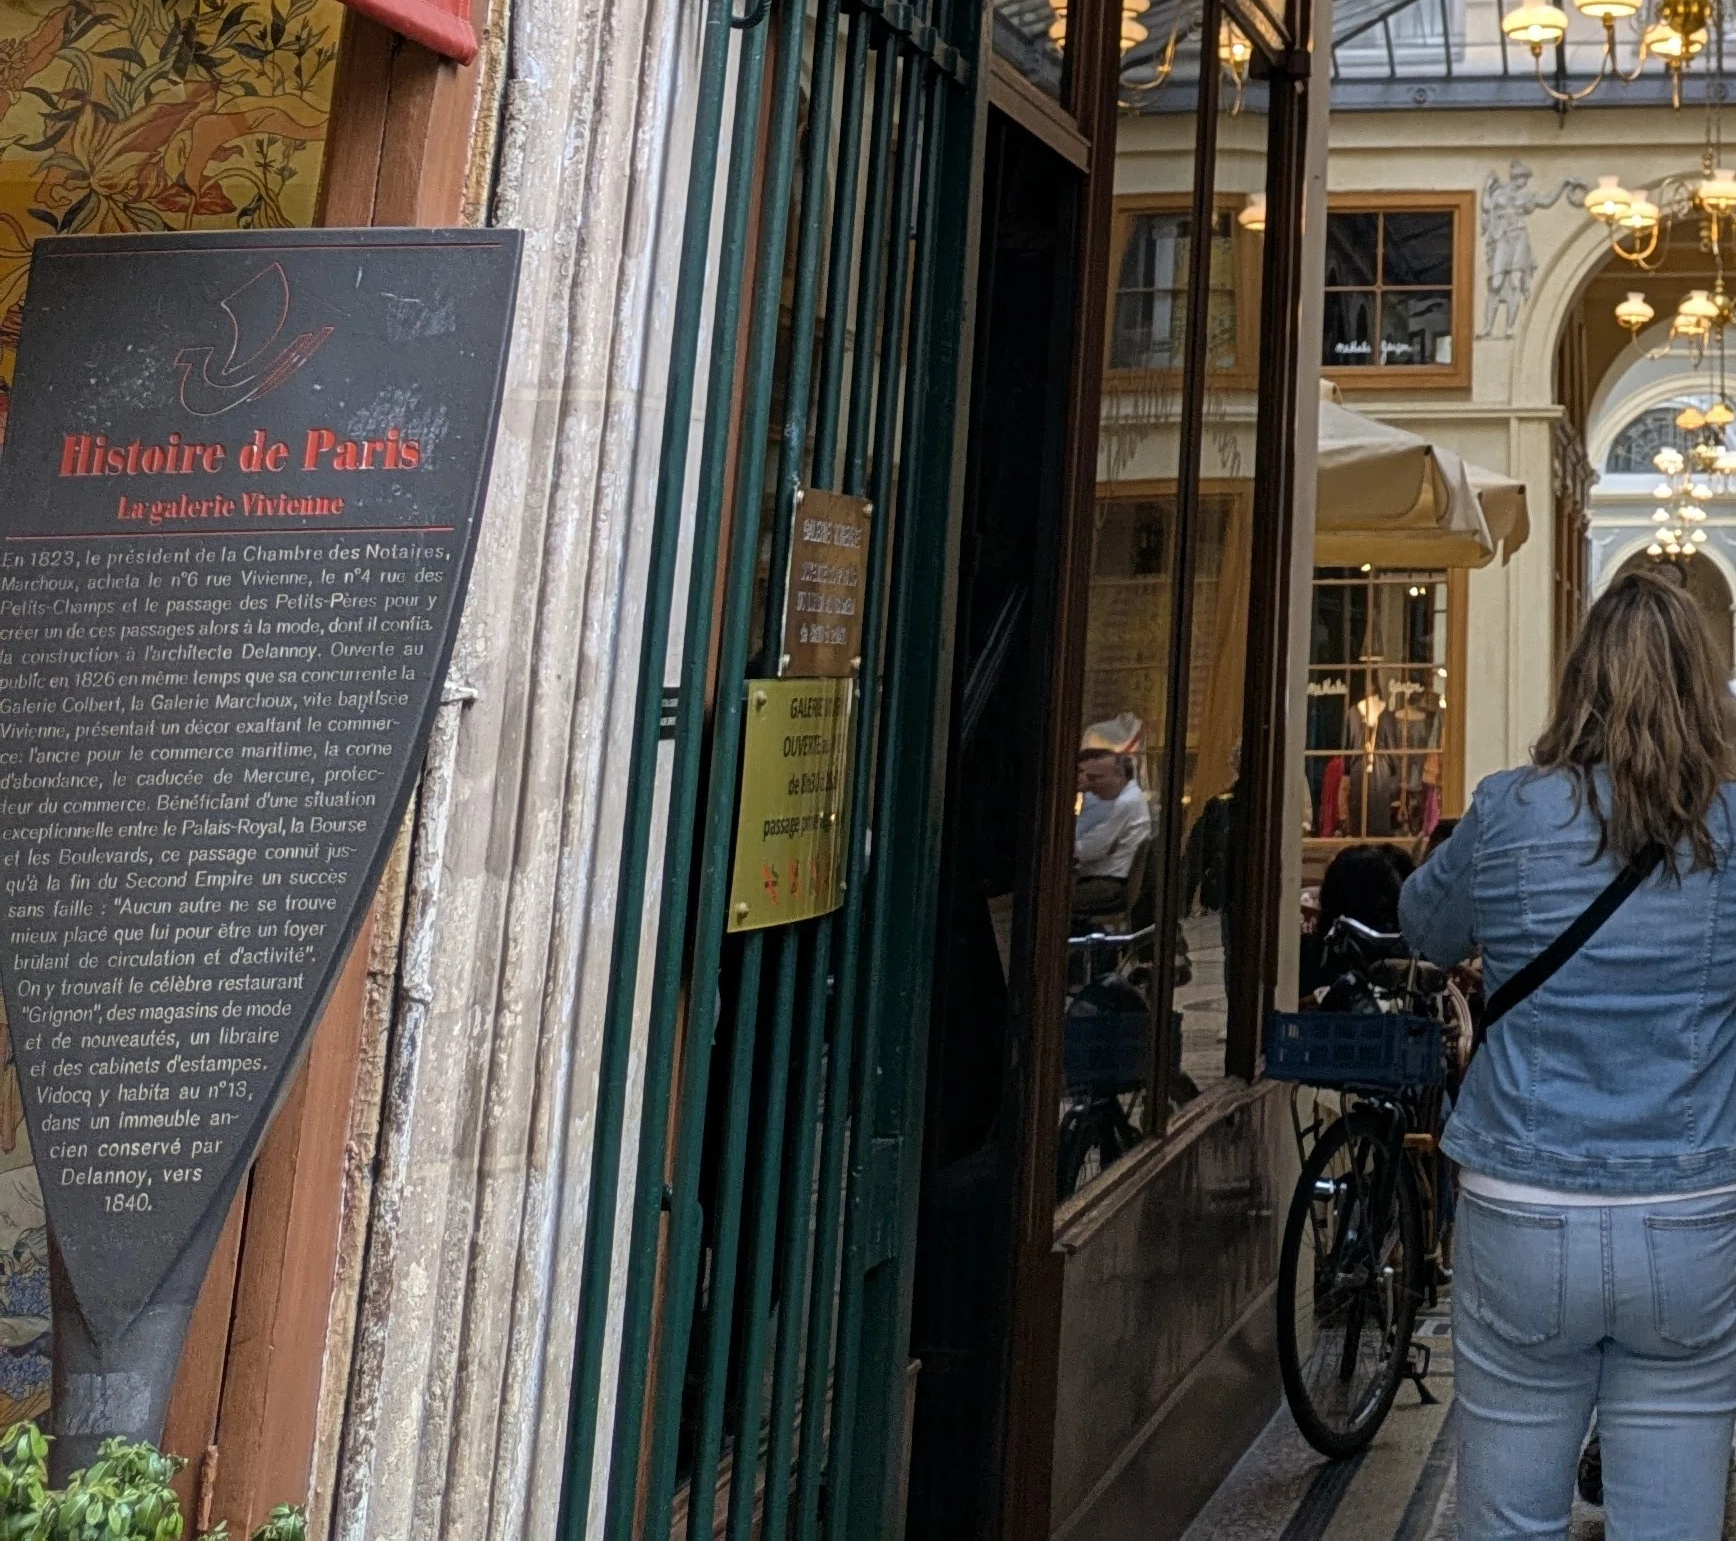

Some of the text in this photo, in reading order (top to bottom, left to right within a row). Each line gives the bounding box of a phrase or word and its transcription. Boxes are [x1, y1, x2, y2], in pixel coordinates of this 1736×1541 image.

[58, 427, 421, 477] Histoire de Paris
[117, 491, 345, 524] La galerie Vivienne
[1, 552, 25, 569] En
[85, 549, 102, 567] le
[195, 547, 217, 564] de
[220, 546, 237, 563] la
[243, 545, 324, 563] Chambre
[328, 544, 362, 561] des
[206, 575, 233, 588] rue
[321, 568, 337, 585] le
[414, 567, 444, 584] des
[144, 597, 160, 613] le
[165, 599, 233, 616] passage
[239, 595, 269, 611] des
[384, 596, 420, 612] pour
[425, 595, 439, 612] y
[66, 622, 86, 640] de
[120, 624, 196, 641] passages
[198, 619, 240, 636] alors
[257, 618, 273, 635] la
[330, 641, 396, 658] Ouverte
[403, 644, 425, 657] au
[49, 676, 70, 689] en
[75, 671, 116, 688] 1826
[193, 670, 242, 688] temps
[245, 671, 276, 689] que
[0, 698, 58, 715] Galerie
[150, 694, 210, 711] Galerie
[303, 692, 333, 708] vite
[236, 717, 302, 734] exaltant
[307, 716, 323, 733] le
[86, 750, 122, 767] pour
[129, 745, 145, 762] le
[150, 747, 235, 761] commerce
[345, 743, 393, 757] corne
[213, 768, 234, 785] de
[38, 797, 59, 815] du
[304, 790, 377, 808] situation
[2, 822, 114, 843] exceptionnelle
[118, 821, 159, 838] entre
[290, 817, 306, 834] la
[310, 816, 368, 834] Bourse
[27, 848, 52, 867] les
[160, 849, 181, 863] ce
[187, 848, 258, 866] passage
[46, 874, 62, 892] la
[70, 873, 91, 891] fin
[98, 872, 119, 891] du
[125, 871, 189, 890] Second
[194, 870, 254, 891] Empire
[7, 905, 46, 919] sans
[53, 899, 94, 918] faille
[178, 897, 222, 914] autre
[229, 899, 250, 913] ne
[285, 895, 338, 912] trouve
[10, 931, 58, 944] mieux
[113, 928, 145, 946] que
[149, 923, 171, 941] lui
[174, 926, 214, 944] pour
[284, 920, 328, 942] foyer
[78, 952, 100, 970] de
[107, 950, 196, 968] circulation
[203, 948, 222, 966] et
[17, 974, 305, 998] On trouvait le célèbre restaurant
[106, 1004, 138, 1022] des
[139, 1005, 219, 1024] magasins
[221, 1000, 243, 1019] de
[246, 999, 293, 1018] mode
[51, 1032, 73, 1050] de
[219, 1027, 280, 1045] libraire
[52, 1058, 84, 1077] des
[89, 1057, 161, 1076] cabinets
[37, 1086, 93, 1107] Vidocq
[117, 1083, 171, 1102] habita
[178, 1086, 202, 1101] au
[41, 1114, 82, 1132] dans
[90, 1116, 111, 1131] un
[49, 1139, 224, 1159] cien conservé par
[163, 1168, 204, 1183] vers
